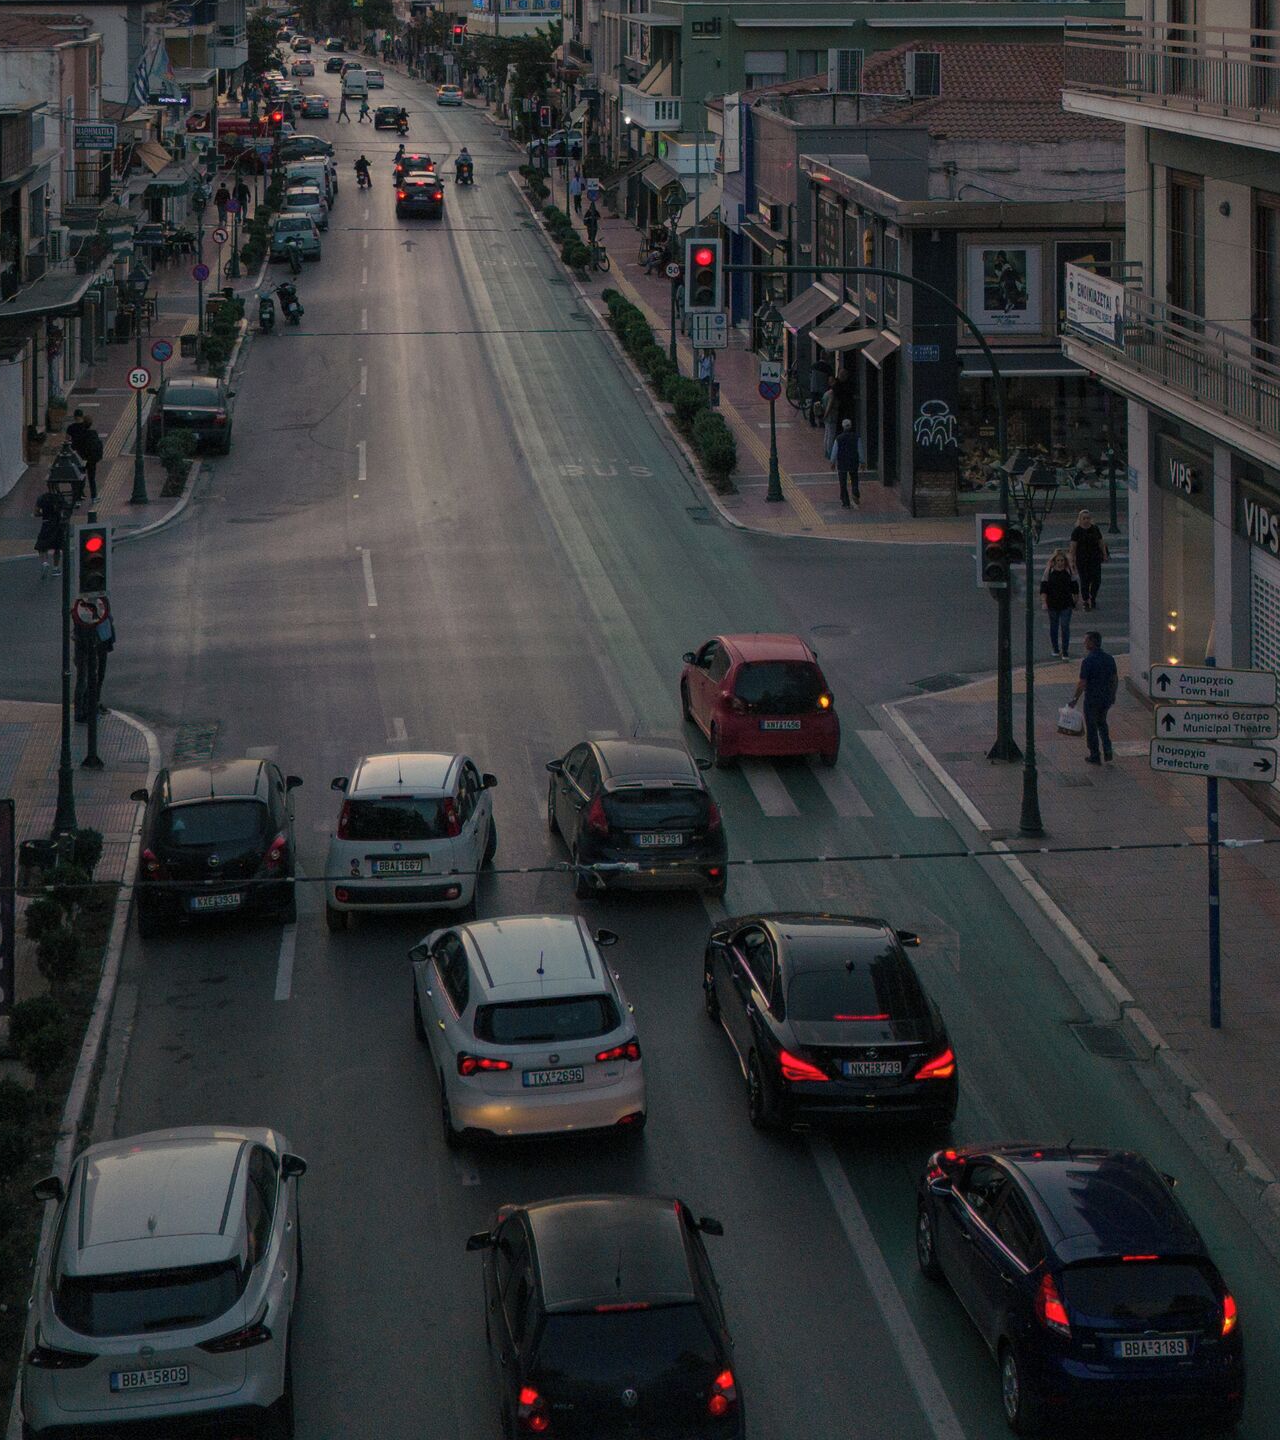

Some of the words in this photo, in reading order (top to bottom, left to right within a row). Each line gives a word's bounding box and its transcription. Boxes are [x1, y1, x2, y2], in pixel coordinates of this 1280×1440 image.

[132, 372, 146, 384] 50
[1170, 458, 1194, 494] VIPS
[1244, 498, 1280, 554] VIPS
[1179, 673, 1234, 687] Δημαρχείο
[1179, 685, 1207, 696] Town
[1209, 688, 1230, 698] Hall
[1183, 711, 1229, 722] Δημοτικό
[1232, 711, 1270, 722] Θέατρο
[1182, 723, 1231, 735] Municipal
[1233, 723, 1272, 733] Theatre
[1156, 745, 1206, 758] Νομαρχία
[1156, 757, 1210, 771] Prefecture
